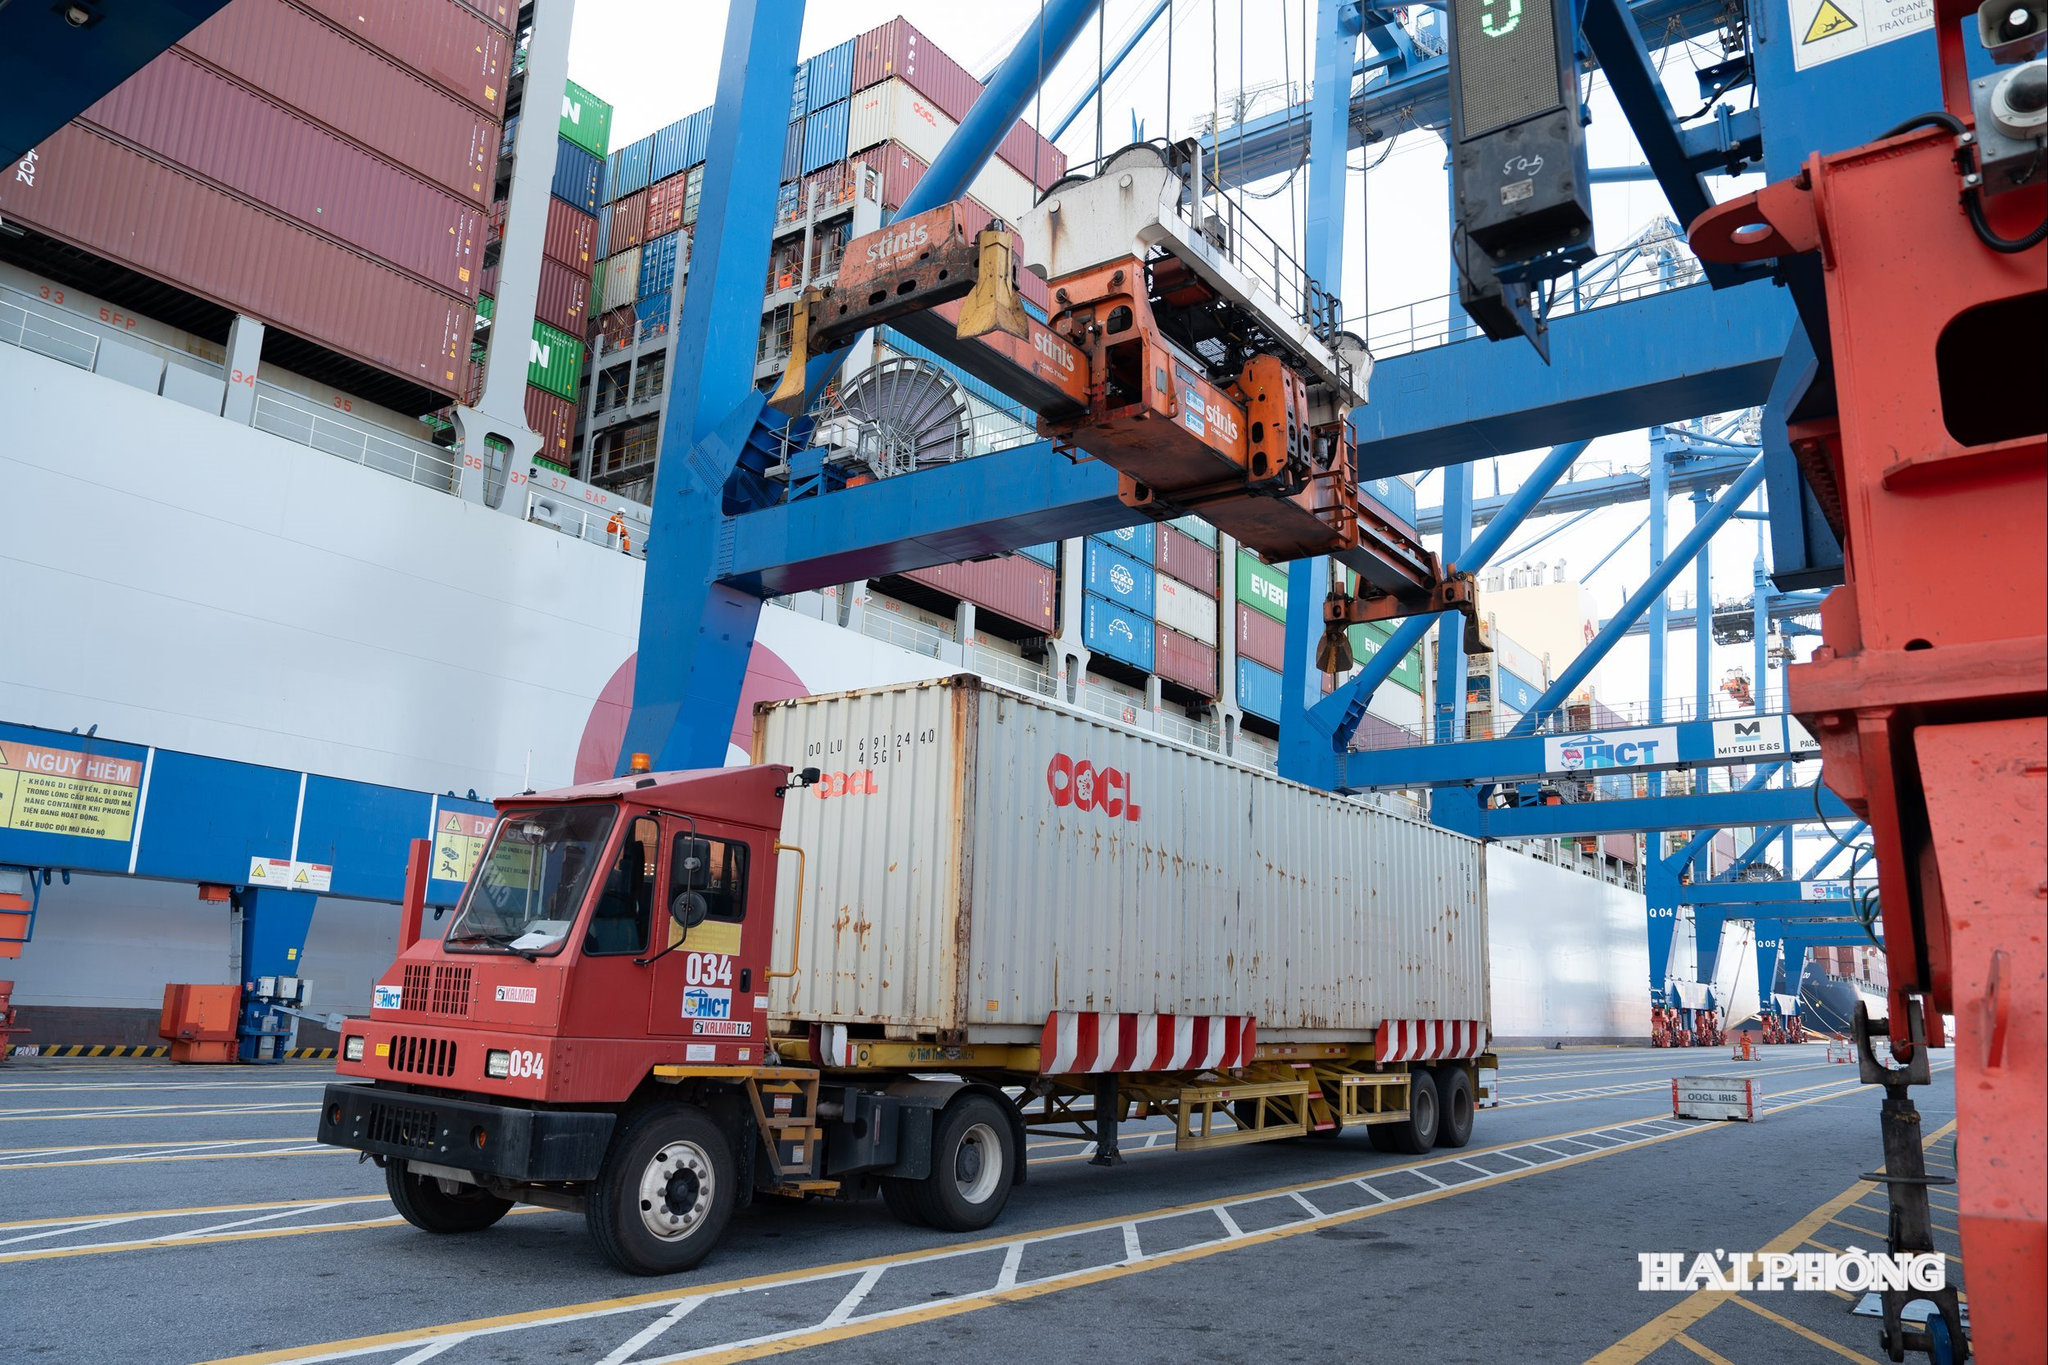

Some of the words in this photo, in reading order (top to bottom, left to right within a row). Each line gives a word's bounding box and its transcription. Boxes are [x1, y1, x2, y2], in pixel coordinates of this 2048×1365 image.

[1891, 1, 1928, 18] CRANE
[866, 222, 929, 263] stinis
[39, 285, 65, 304] 33
[99, 307, 137, 330] 5FP
[1034, 332, 1075, 372] stinis
[231, 369, 255, 388] 34
[333, 396, 353, 412] 35
[1206, 404, 1238, 440] stinis
[464, 454, 482, 470] 35
[510, 471, 528, 486] 37
[551, 477, 567, 491] 37
[585, 489, 608, 504] 5AP
[1583, 740, 1659, 769] HICT
[1718, 745, 1756, 754] MITSUI
[1759, 743, 1780, 751] E&S
[25, 751, 82, 774] NGUY
[86, 760, 132, 782] HIỂM
[26, 787, 49, 797] TRONG
[812, 768, 879, 800] OOCL
[1046, 752, 1142, 822] OOCL
[47, 799, 87, 811] CONTAINER
[1649, 908, 1657, 918] Q
[1659, 907, 1673, 917] 04
[1757, 940, 1764, 948] Q
[1765, 940, 1776, 948] 05
[686, 953, 732, 986] 034
[382, 993, 401, 1008] HICT
[505, 988, 535, 1002] KALMAR
[697, 997, 730, 1017] HICT
[509, 1050, 544, 1080] 034
[1687, 1092, 1714, 1101] OOCL
[1718, 1094, 1738, 1102] IRIS
